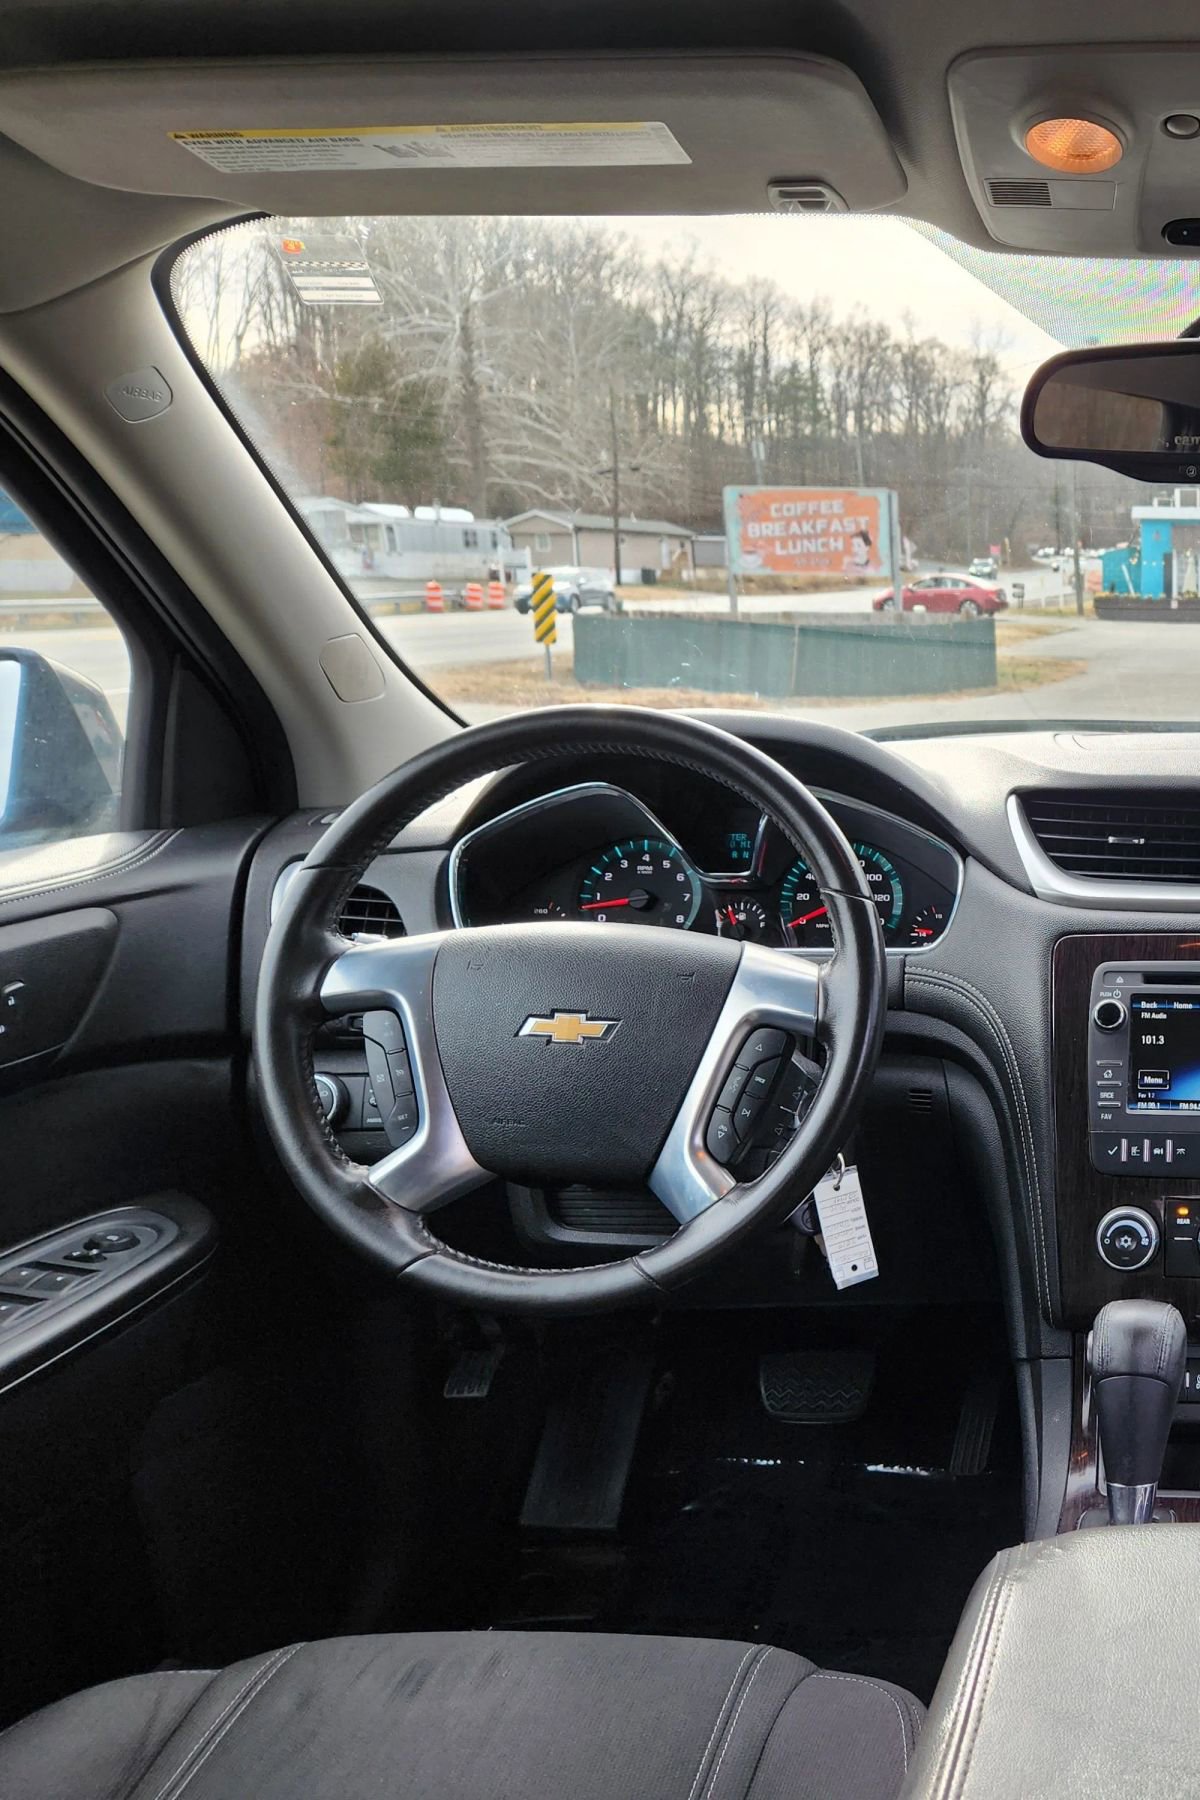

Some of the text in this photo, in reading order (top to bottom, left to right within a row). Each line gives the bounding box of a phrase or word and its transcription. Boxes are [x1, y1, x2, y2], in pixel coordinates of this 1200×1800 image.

[189, 131, 244, 139] WARNING
[770, 500, 844, 518] COFFEE
[747, 516, 870, 538] BREAKFAST
[775, 538, 844, 556] LUNCH
[642, 853, 650, 862] 4
[620, 859, 629, 868] 3
[662, 860, 671, 868] 5
[604, 872, 613, 881] 2
[676, 873, 685, 881] 6
[866, 873, 883, 881] 100
[596, 892, 601, 900] 1
[683, 893, 691, 901] 7
[796, 893, 810, 901] 20
[874, 894, 890, 902] 120
[598, 914, 606, 922] 0
[676, 915, 684, 923] 8
[1141, 1001, 1158, 1009] Back
[1141, 1035, 1165, 1045] 101.3
[1144, 1076, 1163, 1084] Menu
[1177, 1218, 1191, 1226] REAR
